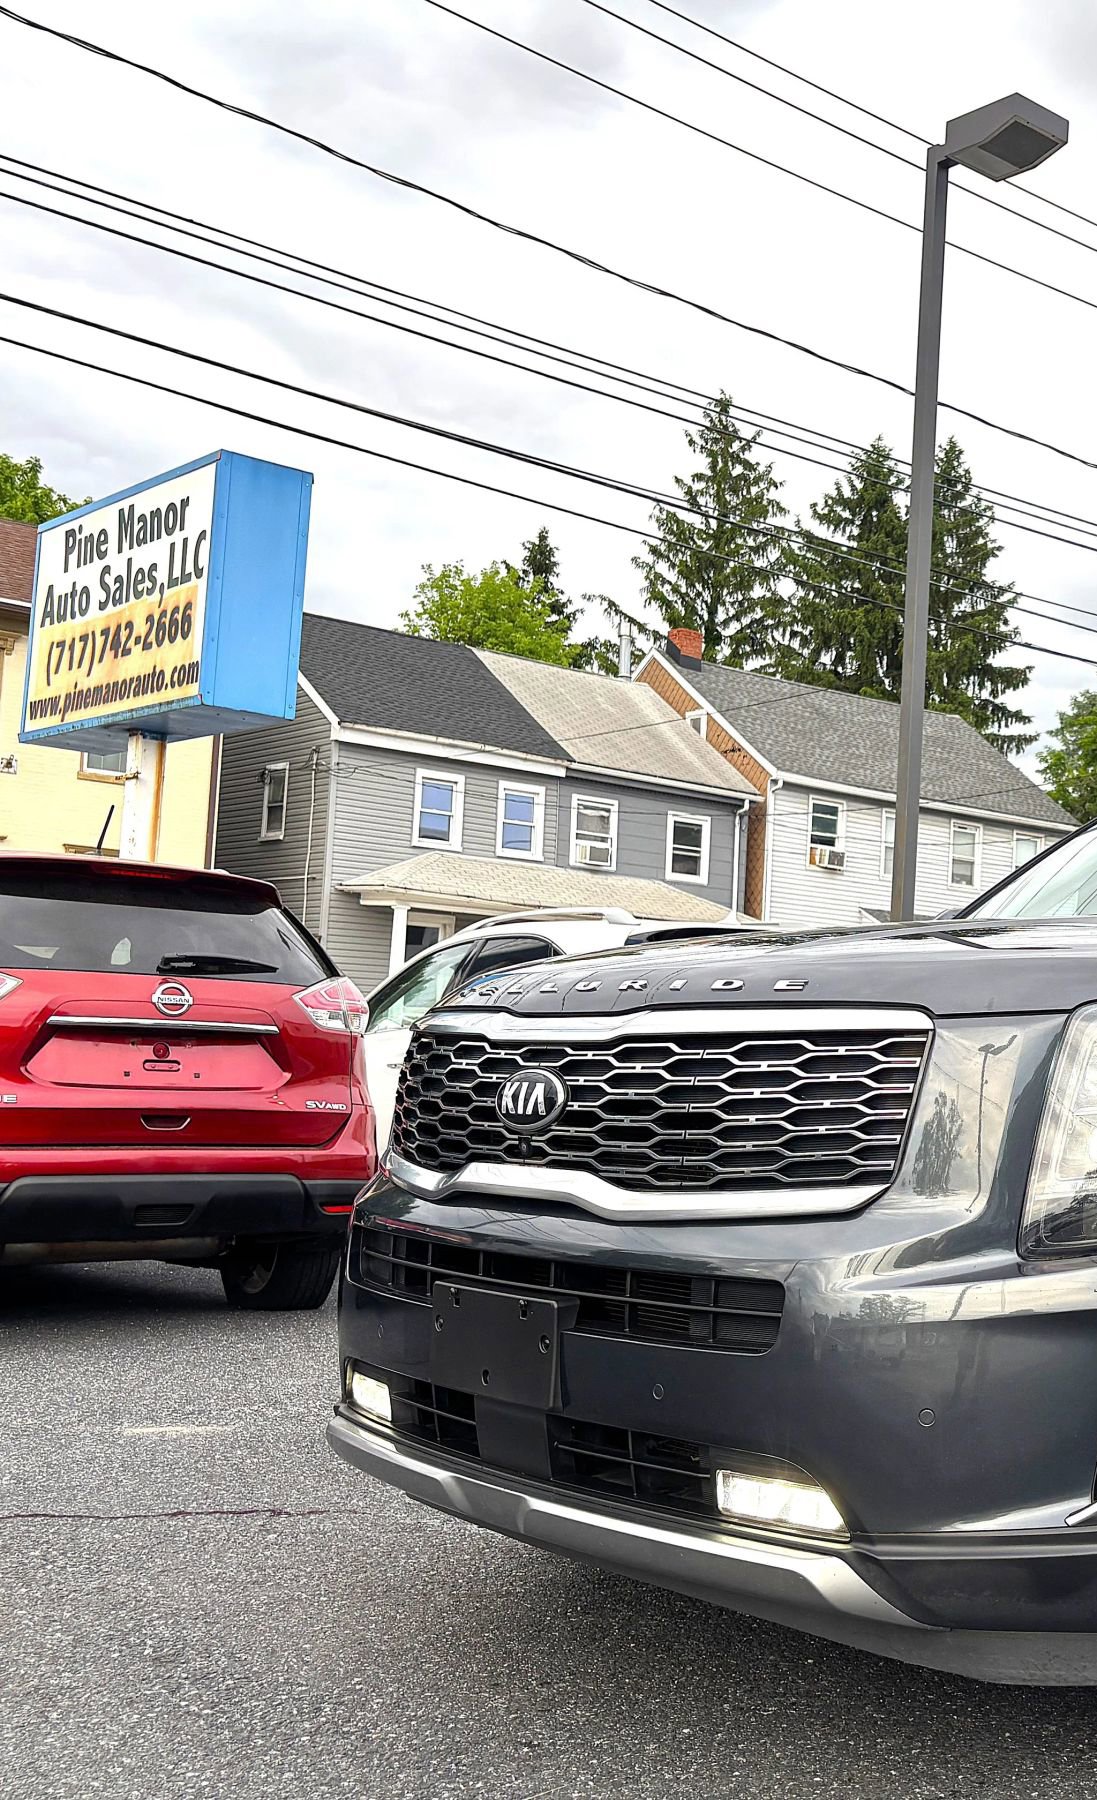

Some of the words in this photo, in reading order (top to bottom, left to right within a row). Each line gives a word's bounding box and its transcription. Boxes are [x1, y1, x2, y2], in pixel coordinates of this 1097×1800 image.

[64, 524, 109, 573] Pine
[117, 496, 190, 554] Manor
[40, 581, 91, 628] Auto
[46, 602, 194, 686] (717)742-2666
[29, 660, 200, 722] www.pinemanorauto.com
[157, 996, 190, 1004] NISSAN
[501, 1081, 546, 1115] KIA
